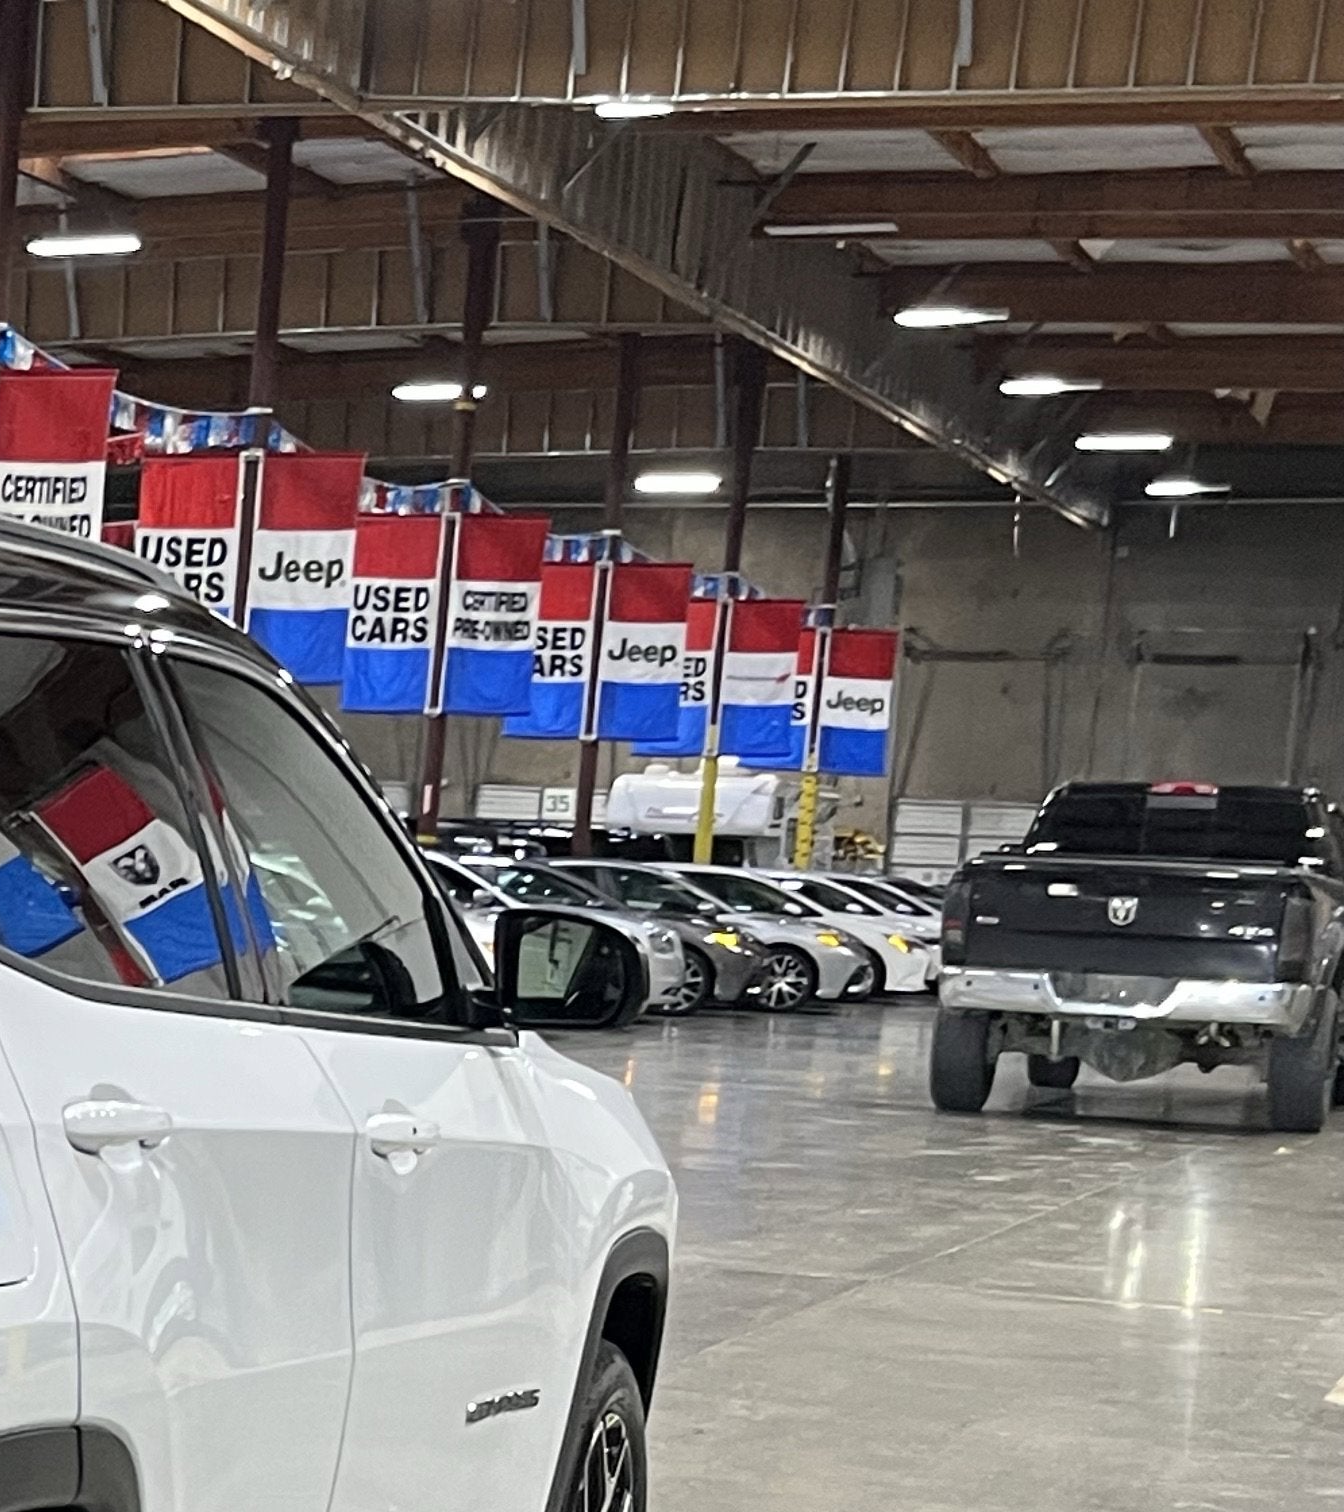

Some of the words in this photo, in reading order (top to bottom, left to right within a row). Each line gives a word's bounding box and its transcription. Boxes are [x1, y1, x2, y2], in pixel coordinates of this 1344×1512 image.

[141, 536, 227, 567] USED
[258, 551, 344, 588] Jeep
[183, 572, 225, 602] RS
[354, 584, 430, 613] USED
[351, 615, 429, 643] CARS
[536, 626, 586, 650] SED
[533, 654, 583, 677] ARS
[607, 637, 678, 667] Jeep
[826, 690, 884, 716] Jeep
